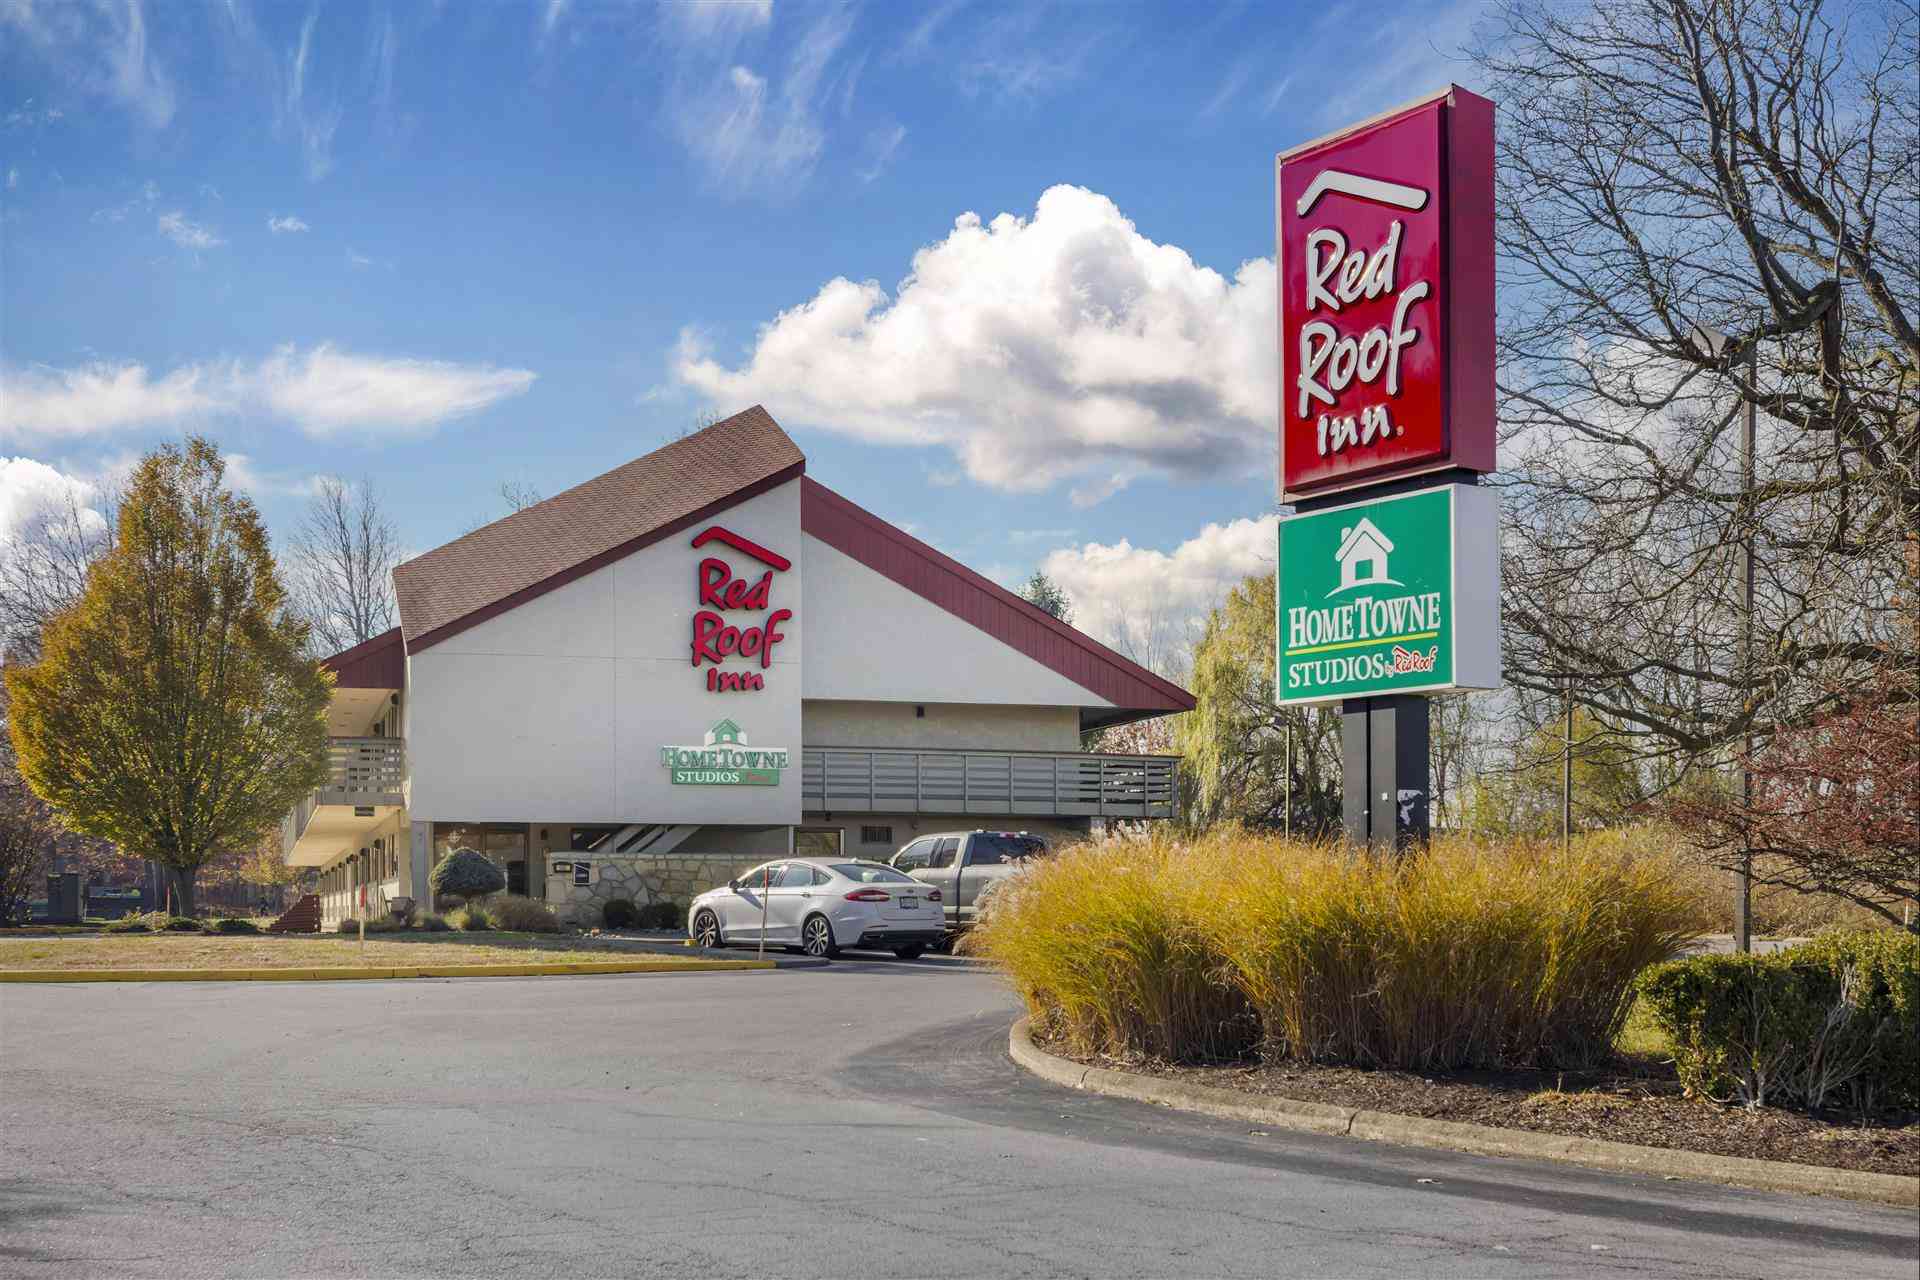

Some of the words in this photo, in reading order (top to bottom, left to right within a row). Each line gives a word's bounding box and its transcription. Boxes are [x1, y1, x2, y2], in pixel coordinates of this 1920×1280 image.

[1306, 220, 1402, 312] Red
[1297, 280, 1430, 419] Roof
[700, 557, 773, 611] Red
[690, 608, 793, 669] Roof
[1288, 653, 1384, 689] STUDIOS
[676, 770, 740, 784] STUDIOS
